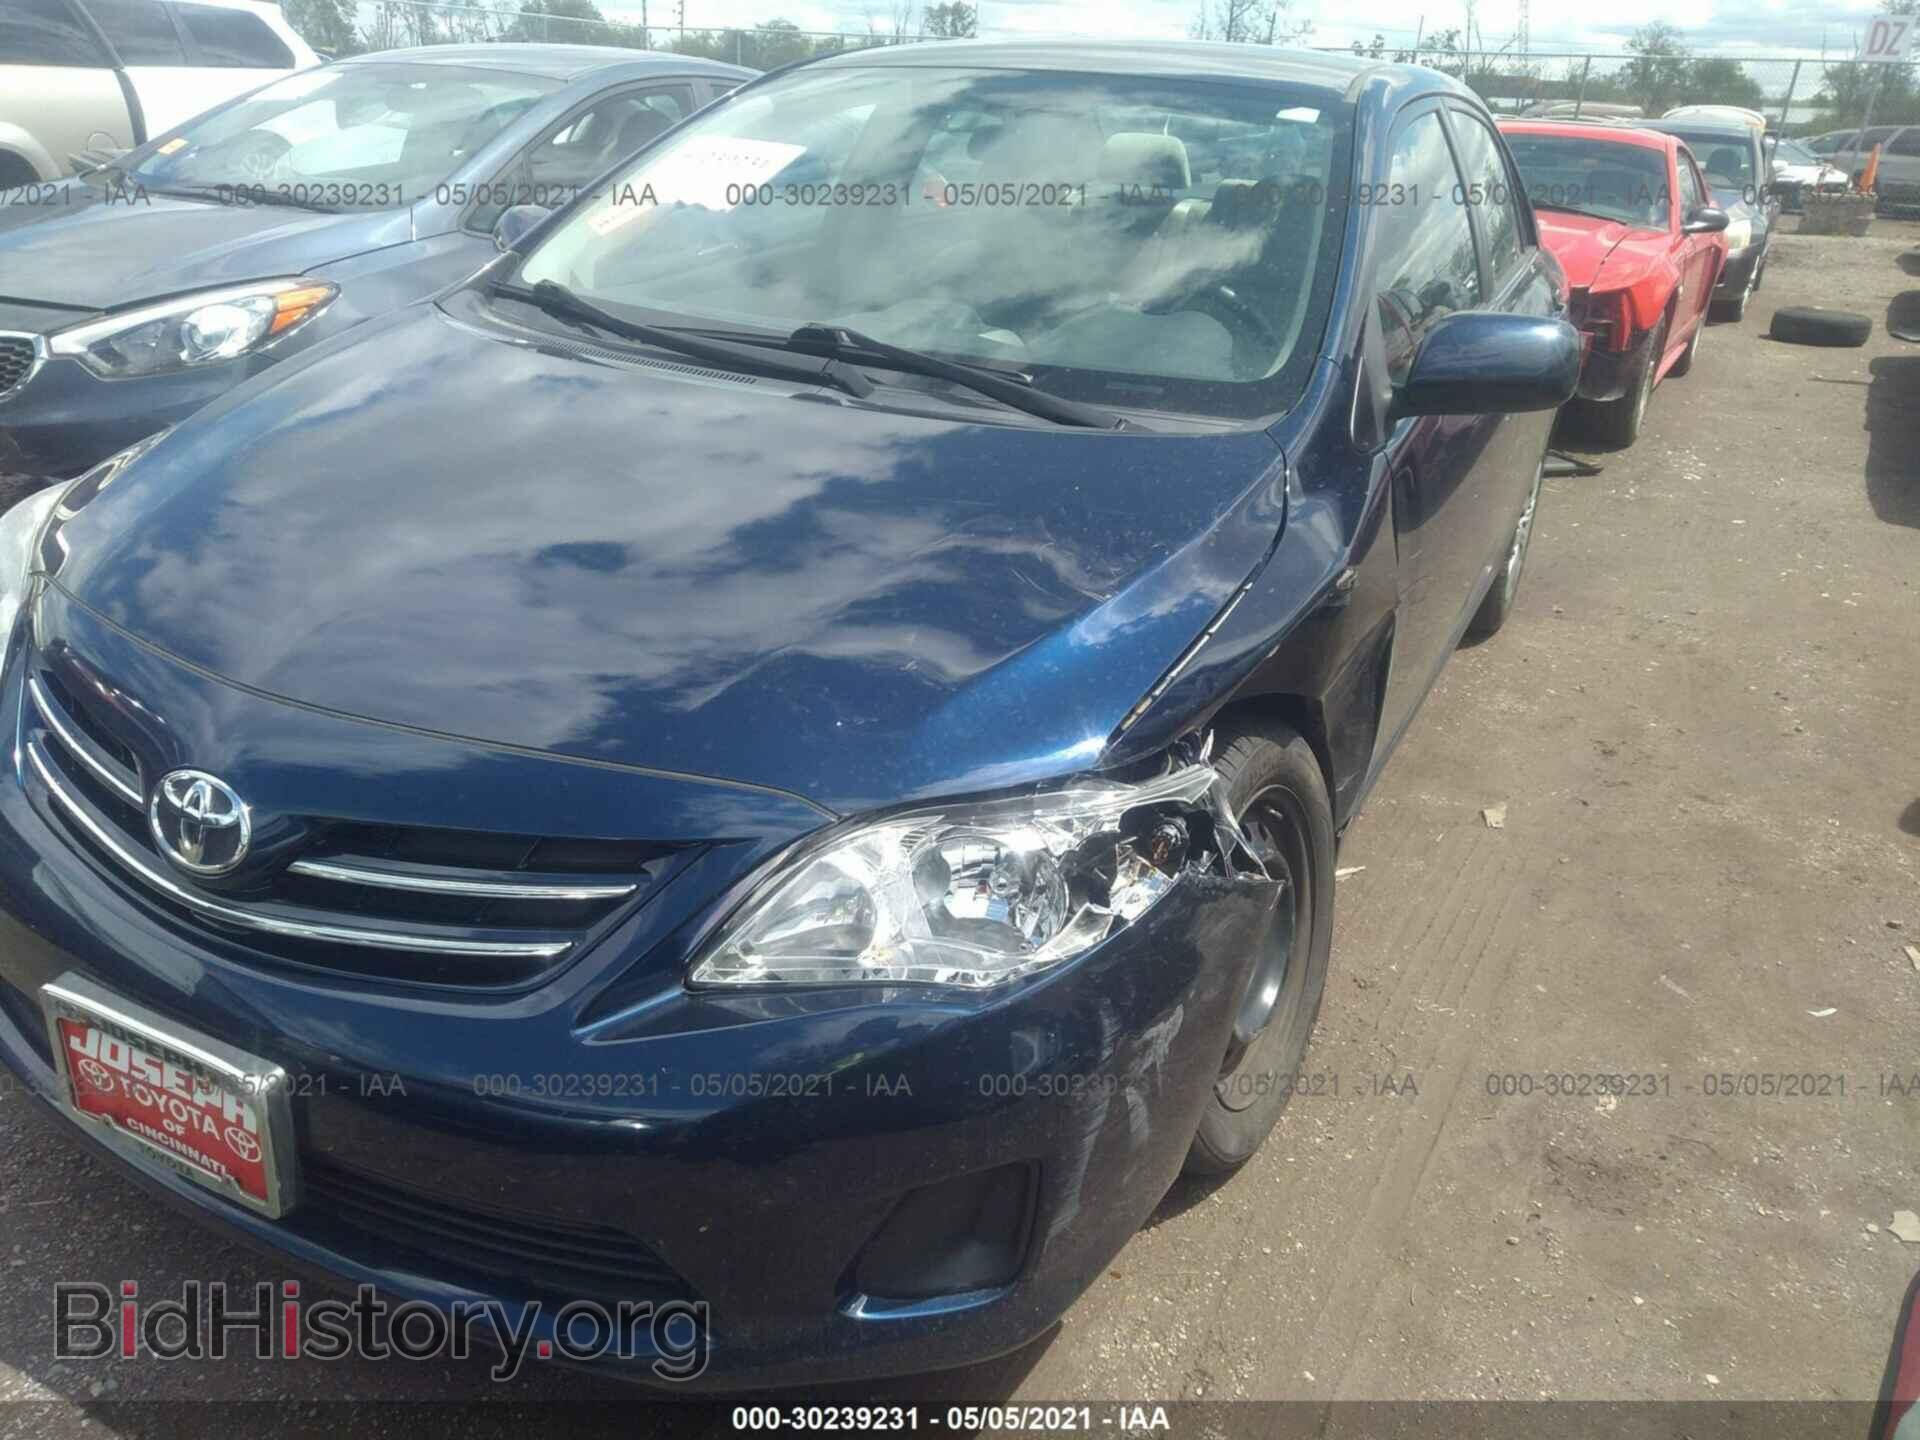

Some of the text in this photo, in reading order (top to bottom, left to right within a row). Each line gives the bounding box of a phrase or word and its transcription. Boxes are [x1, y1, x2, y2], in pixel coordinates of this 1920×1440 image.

[69, 1029, 257, 1133] JOSEPH
[119, 1077, 220, 1141] TOYOTA
[127, 1117, 227, 1175] CINCINNATI
[162, 1119, 187, 1136] OF
